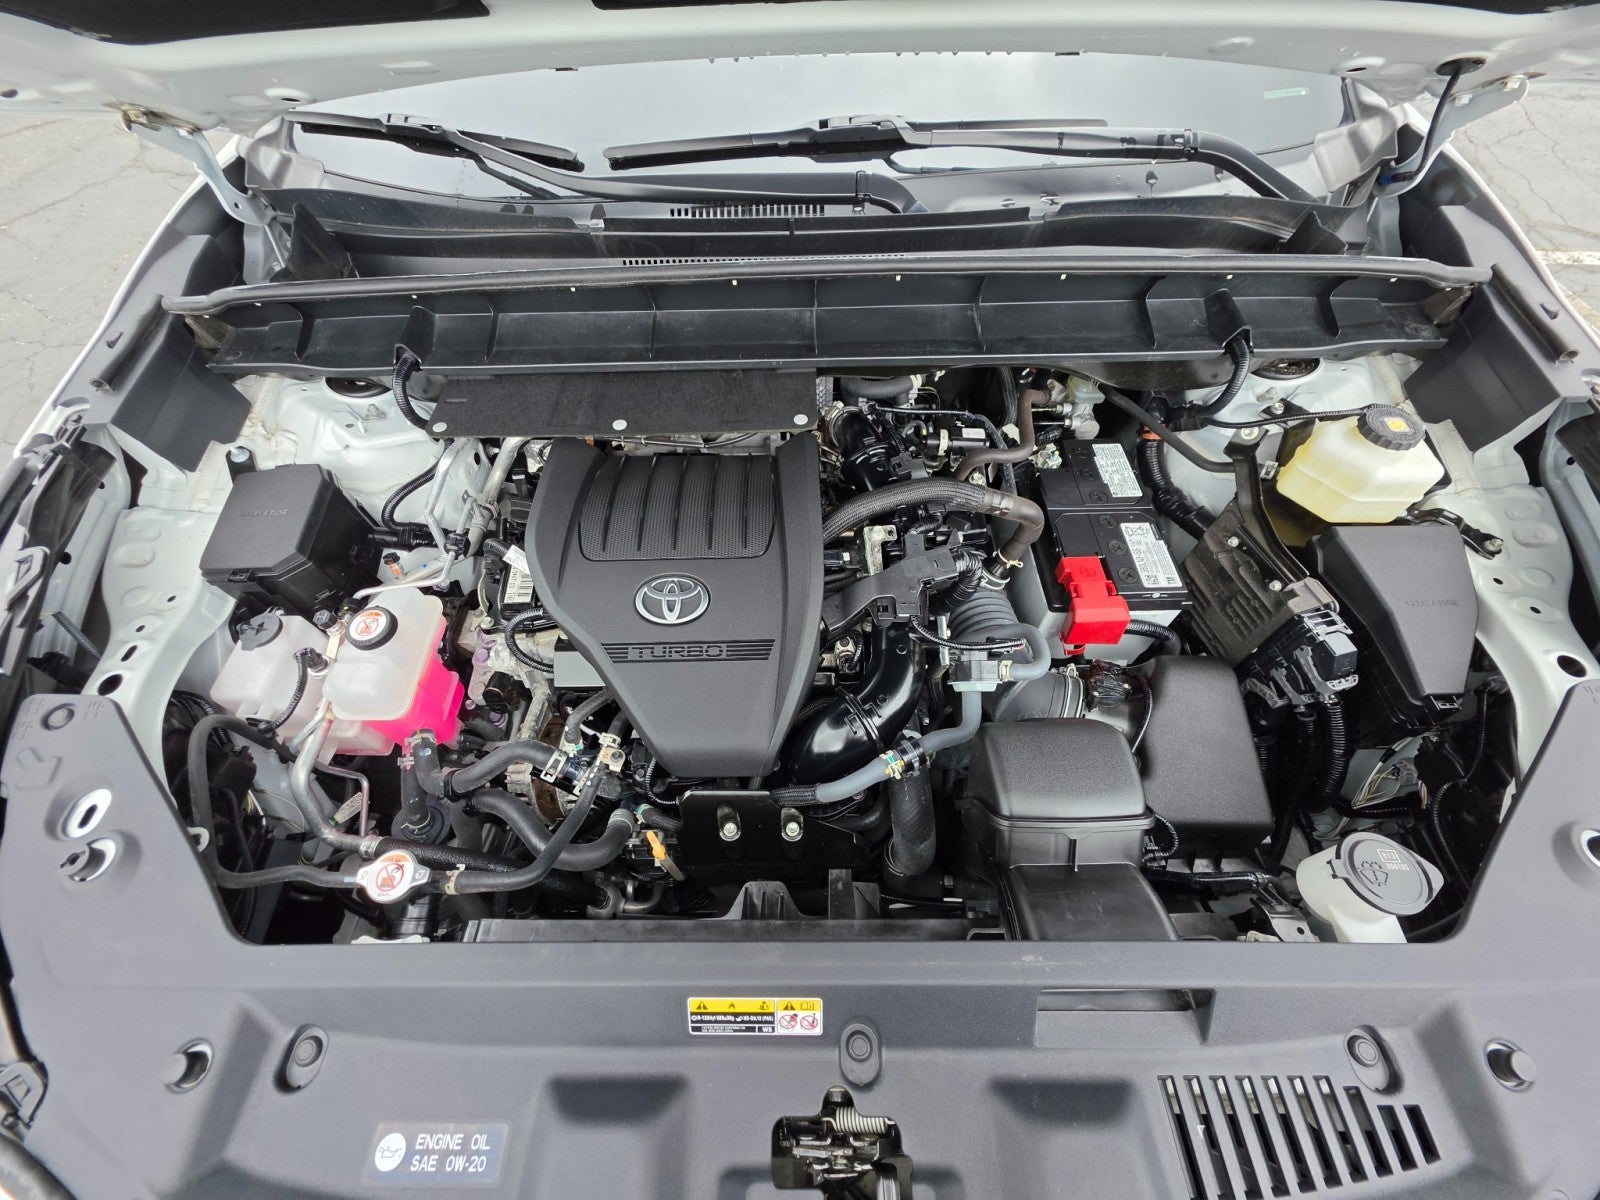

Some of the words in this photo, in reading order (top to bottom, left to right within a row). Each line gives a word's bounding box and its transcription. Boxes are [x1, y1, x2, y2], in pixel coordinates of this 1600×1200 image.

[632, 645, 724, 659] TURBO
[415, 1134, 464, 1150] ENGINE
[471, 1134, 491, 1150] OIL
[410, 1155, 440, 1172] SAE
[445, 1155, 487, 1172] 0W-20
